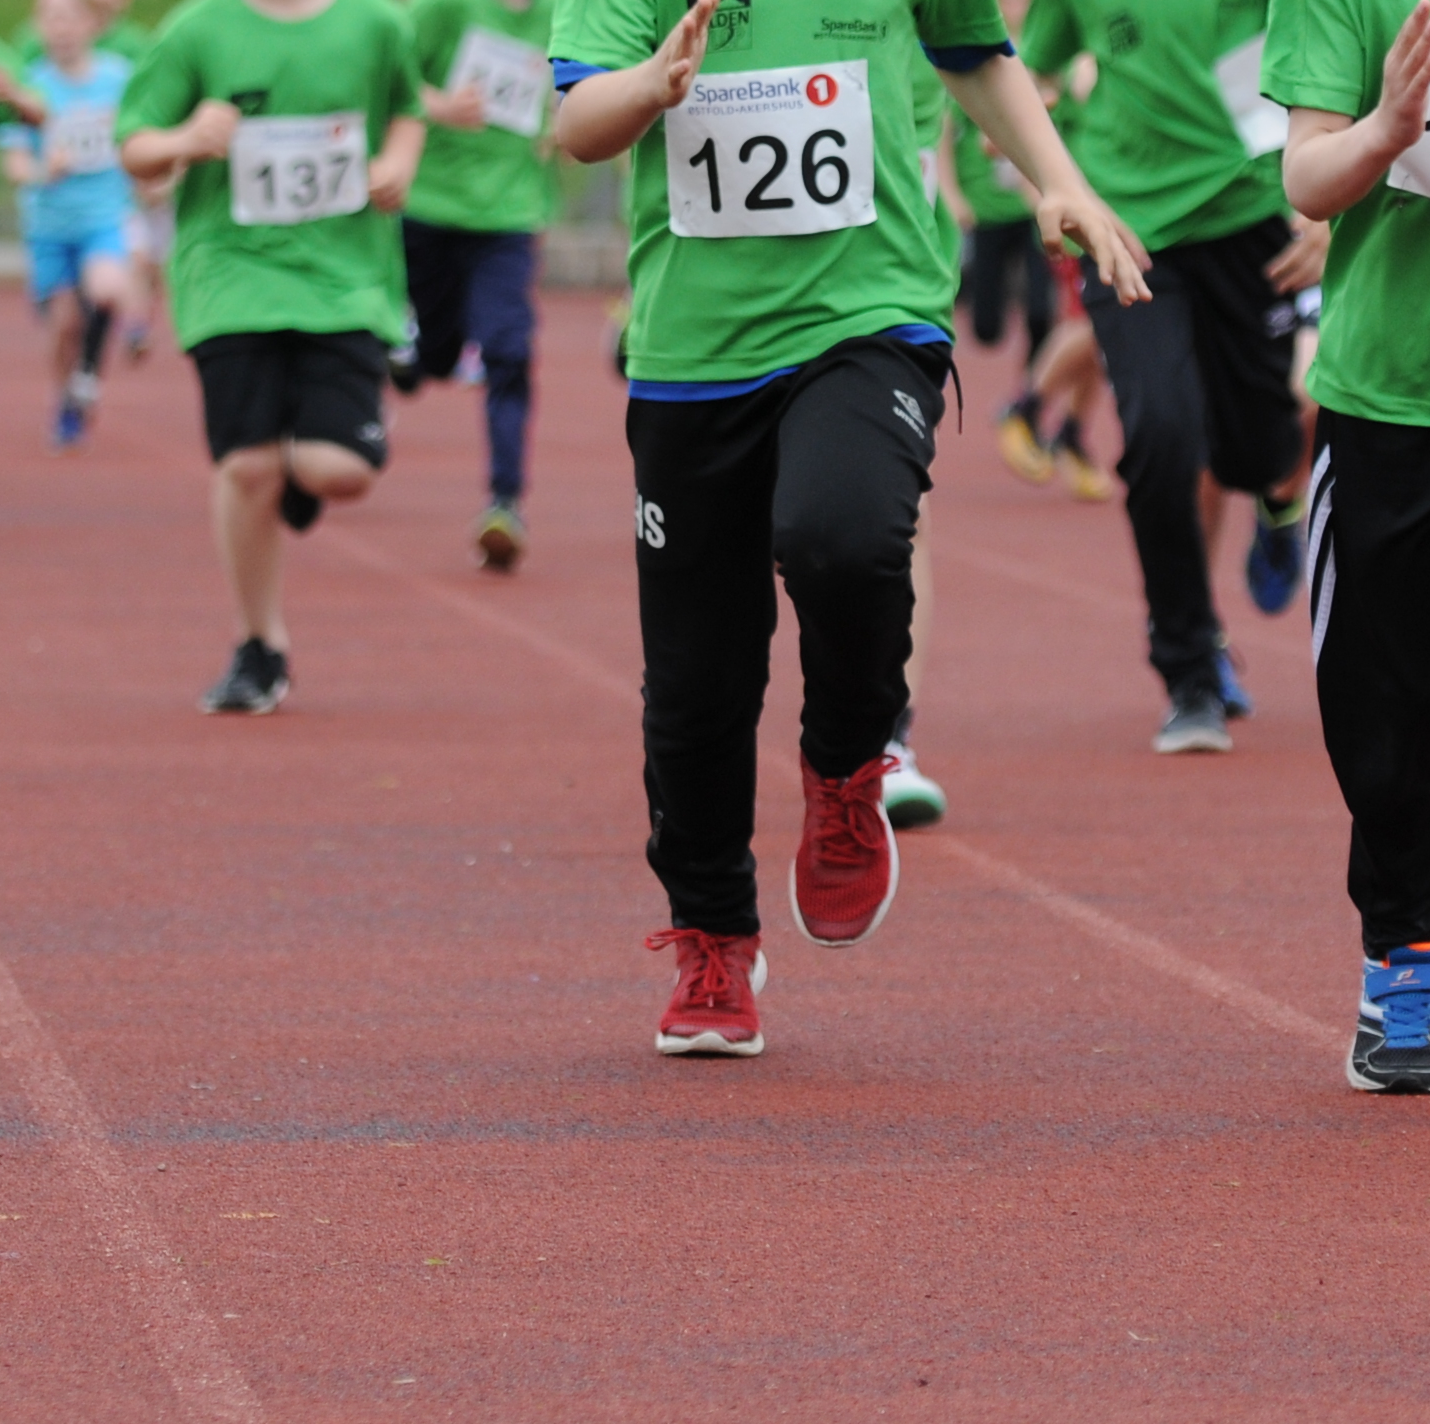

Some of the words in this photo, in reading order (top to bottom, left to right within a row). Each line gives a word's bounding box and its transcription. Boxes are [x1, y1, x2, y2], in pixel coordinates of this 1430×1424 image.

[709, 10, 750, 28] LDEN
[695, 78, 801, 104] SpareBank
[255, 155, 351, 208] 137
[689, 129, 850, 213] 126
